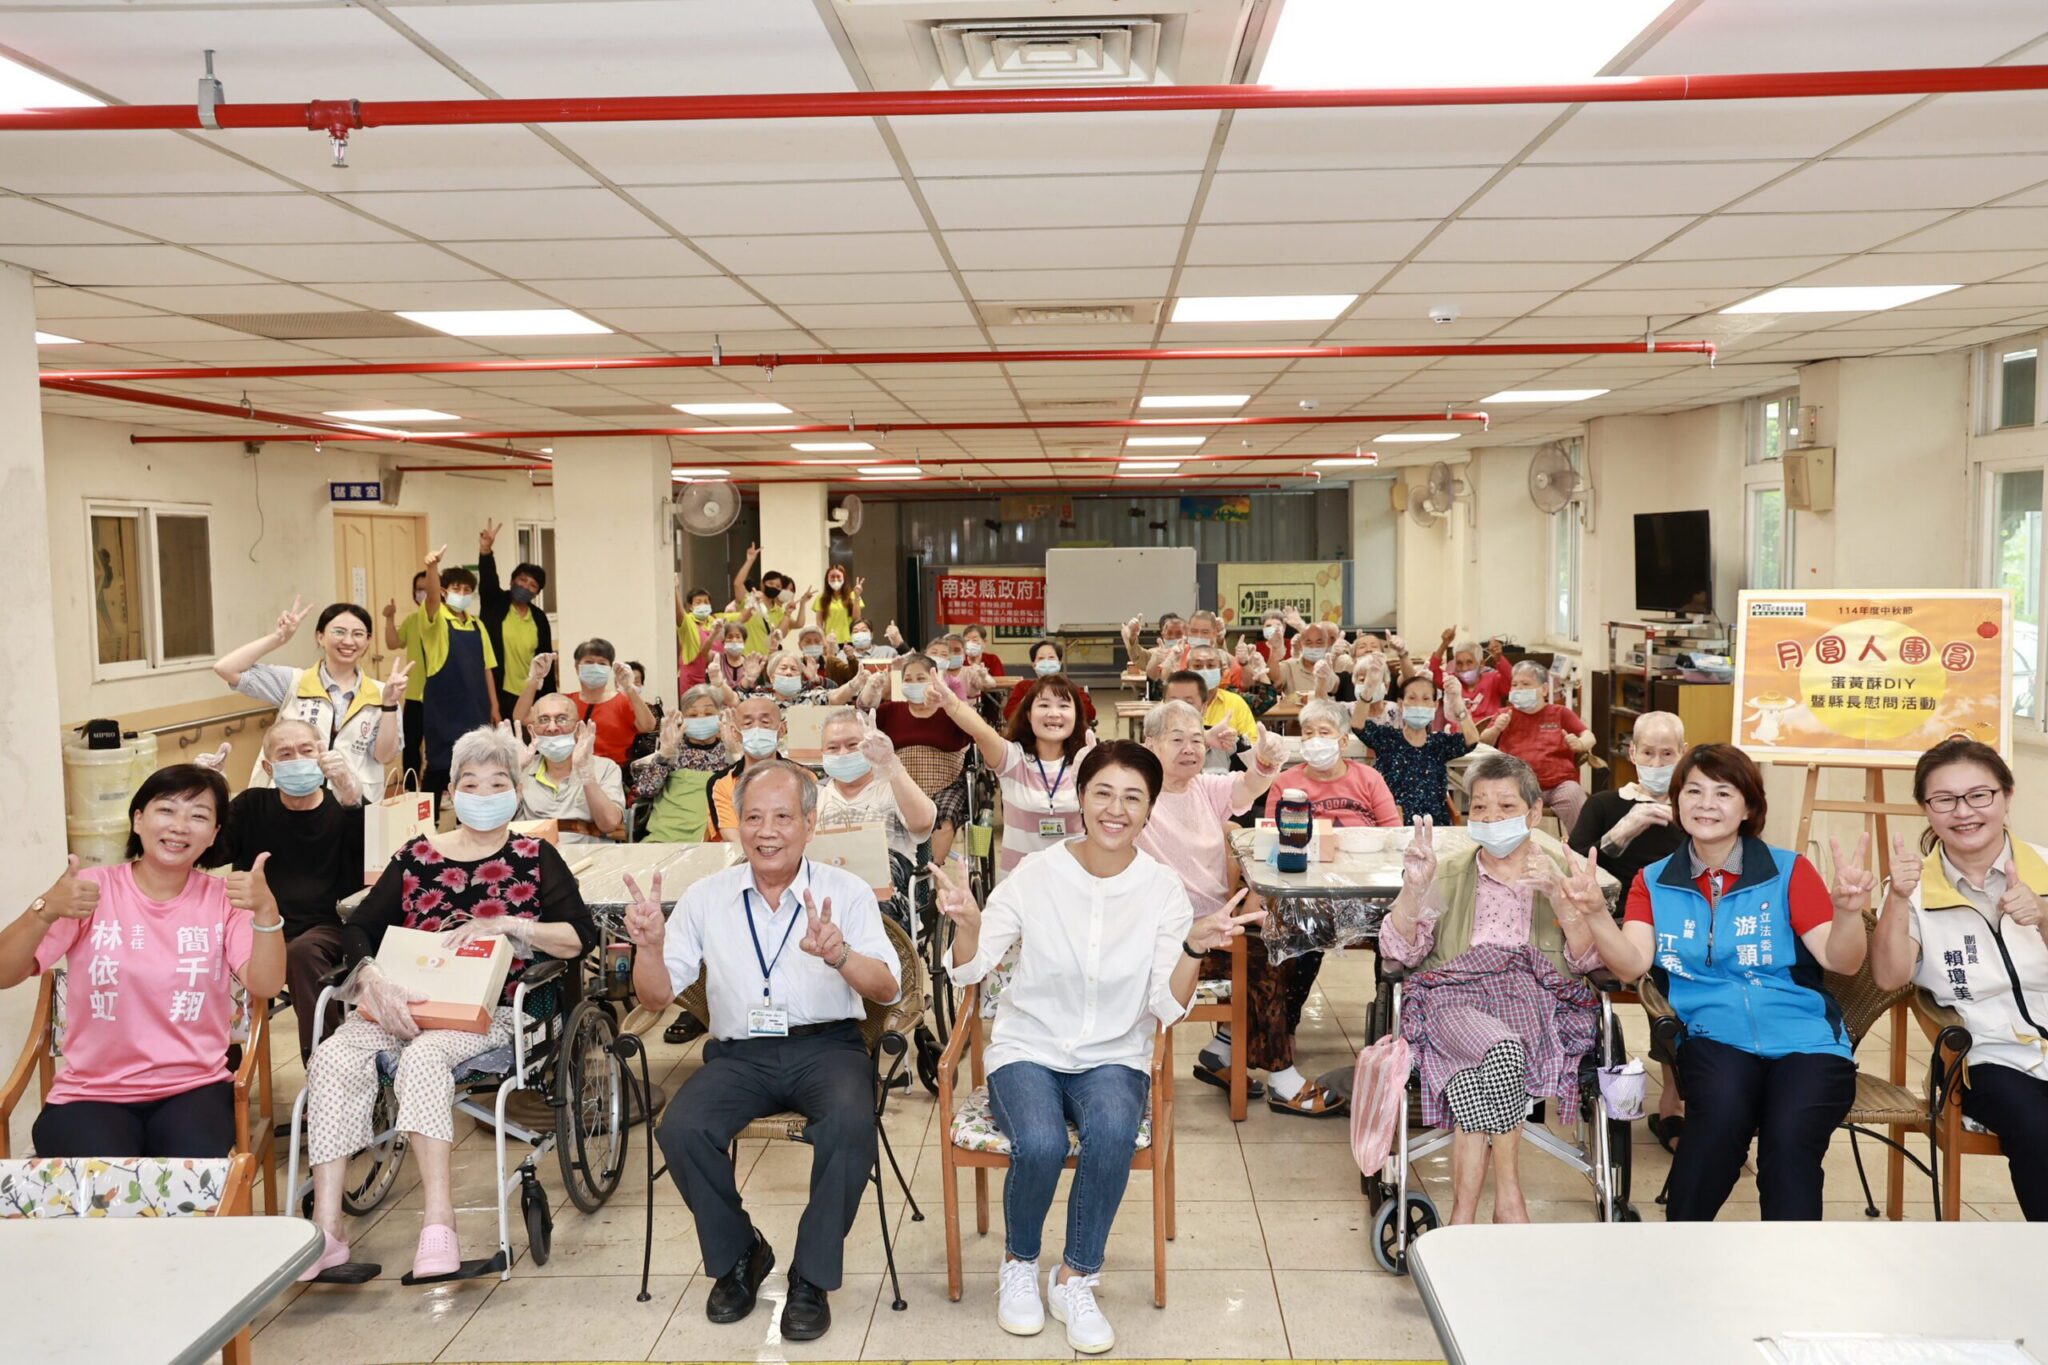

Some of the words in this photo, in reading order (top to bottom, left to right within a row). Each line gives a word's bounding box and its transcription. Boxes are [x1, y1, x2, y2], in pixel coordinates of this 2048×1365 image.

[941, 579, 1046, 600] 南投縣政府1
[1838, 606, 1913, 616] 114年度中秋節
[1776, 635, 1976, 672] 月圓人團圓
[1831, 676, 1916, 690] 蛋黃酥DIY
[1811, 694, 1936, 711] 暨縣長慰問活動
[131, 924, 145, 950] 主任
[1683, 919, 1696, 939] 秘書
[1733, 915, 1759, 966] 游顥
[1760, 912, 1773, 965] 立法委員
[1964, 935, 1979, 964] 副局長
[88, 920, 123, 1021] 林依虹
[169, 926, 209, 1023] 簡千翔
[1944, 950, 1974, 1001] 賴瓊美
